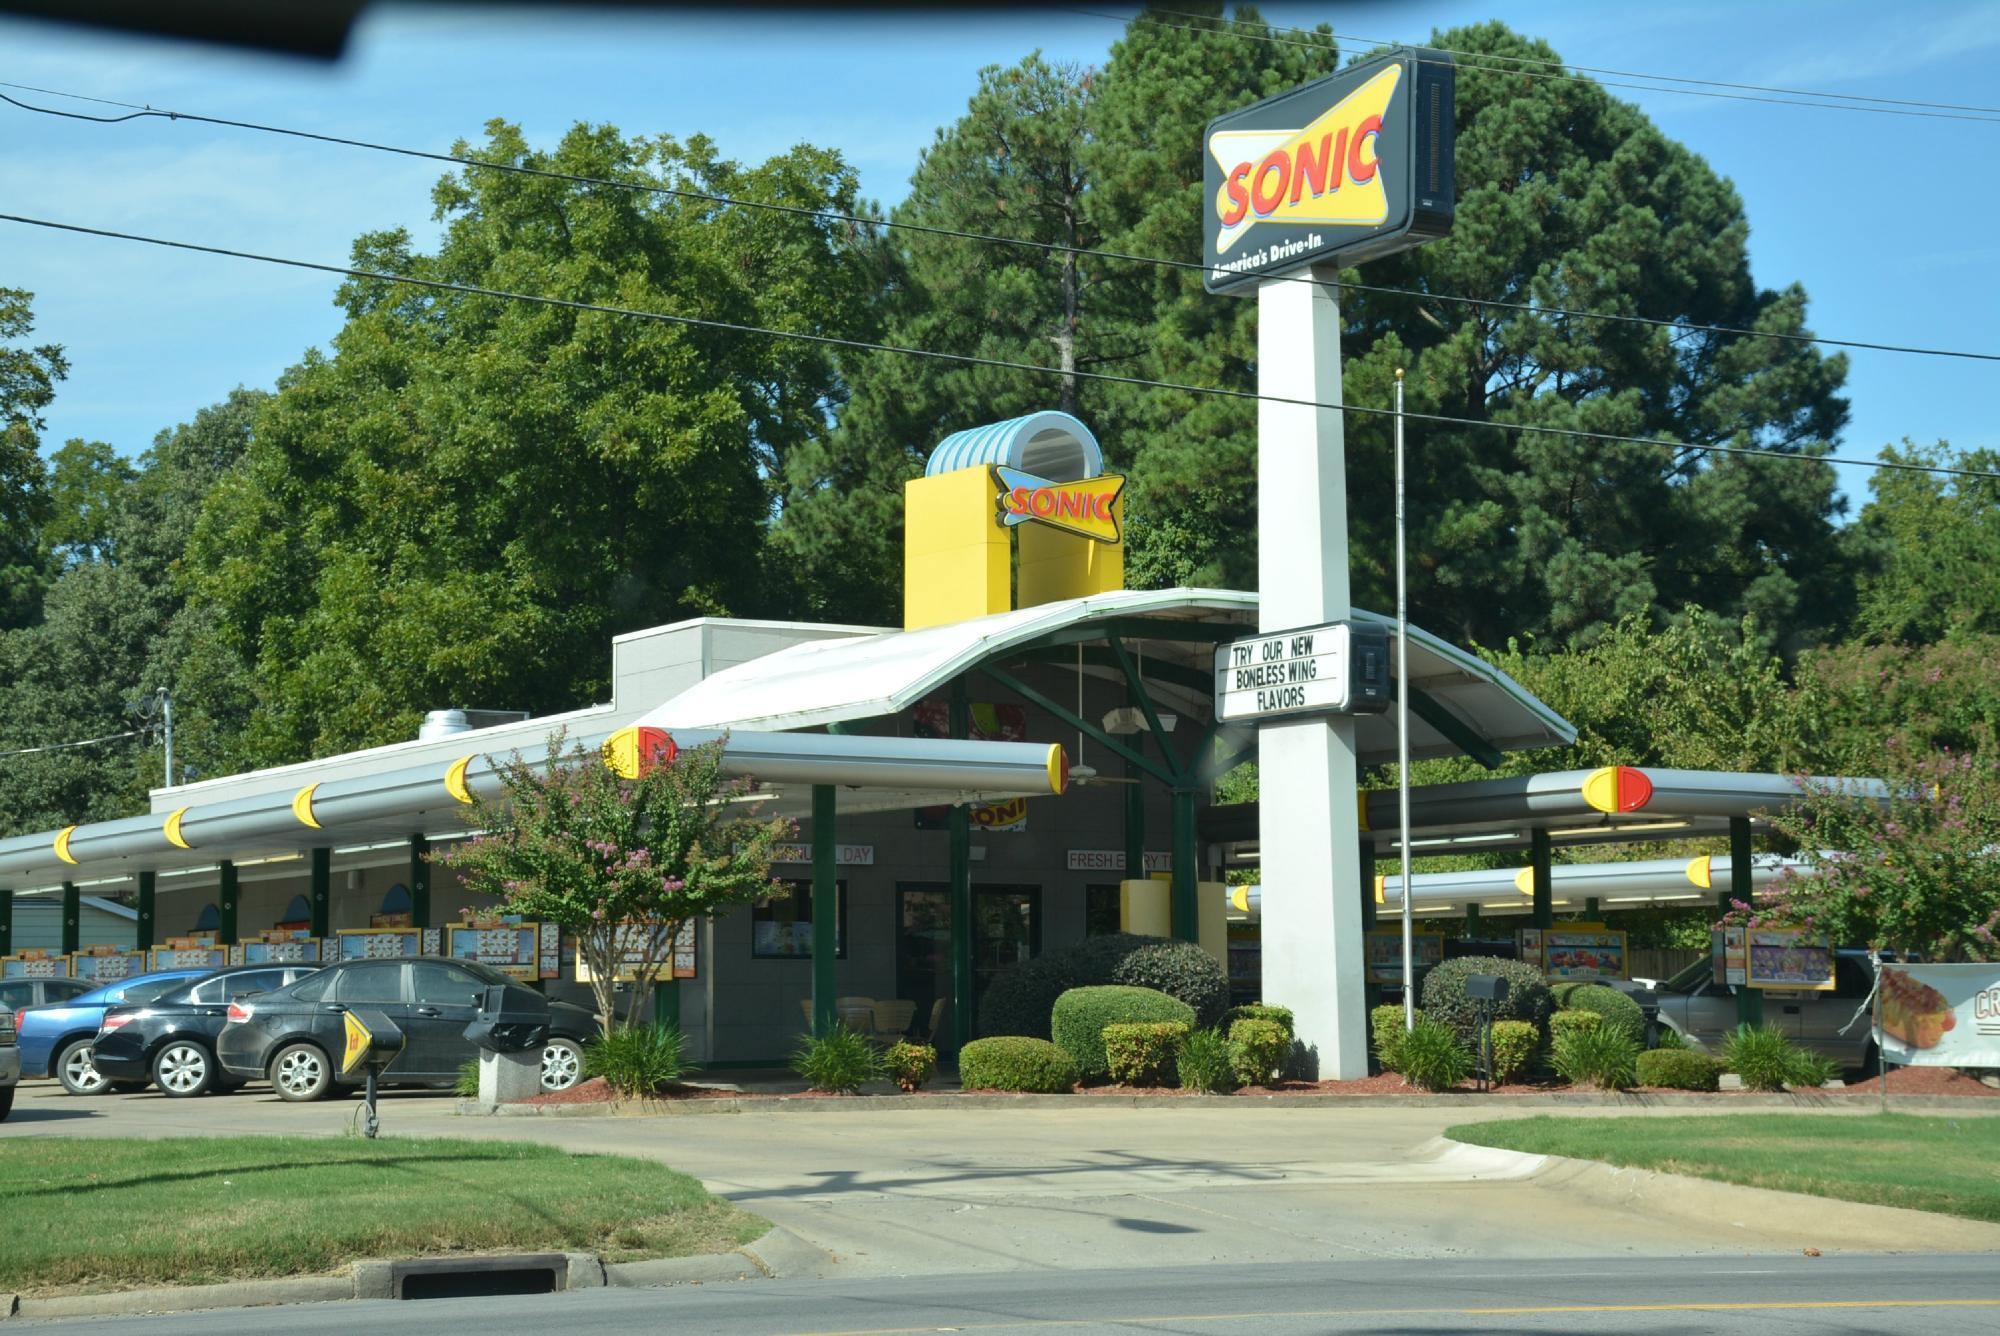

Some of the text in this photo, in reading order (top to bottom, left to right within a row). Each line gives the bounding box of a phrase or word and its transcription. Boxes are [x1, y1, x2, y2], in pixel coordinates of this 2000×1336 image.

[1222, 114, 1382, 228] SONIC
[1211, 249, 1267, 280] America's
[1009, 487, 1115, 522] SONIC
[1233, 635, 1314, 666] TRY OUR NEW
[1236, 660, 1317, 689] BONELESS WING
[1257, 686, 1305, 711] FLAVORS
[844, 847, 871, 863] DAY
[1069, 853, 1113, 868] FRESH
[1117, 853, 1158, 869] ERY
